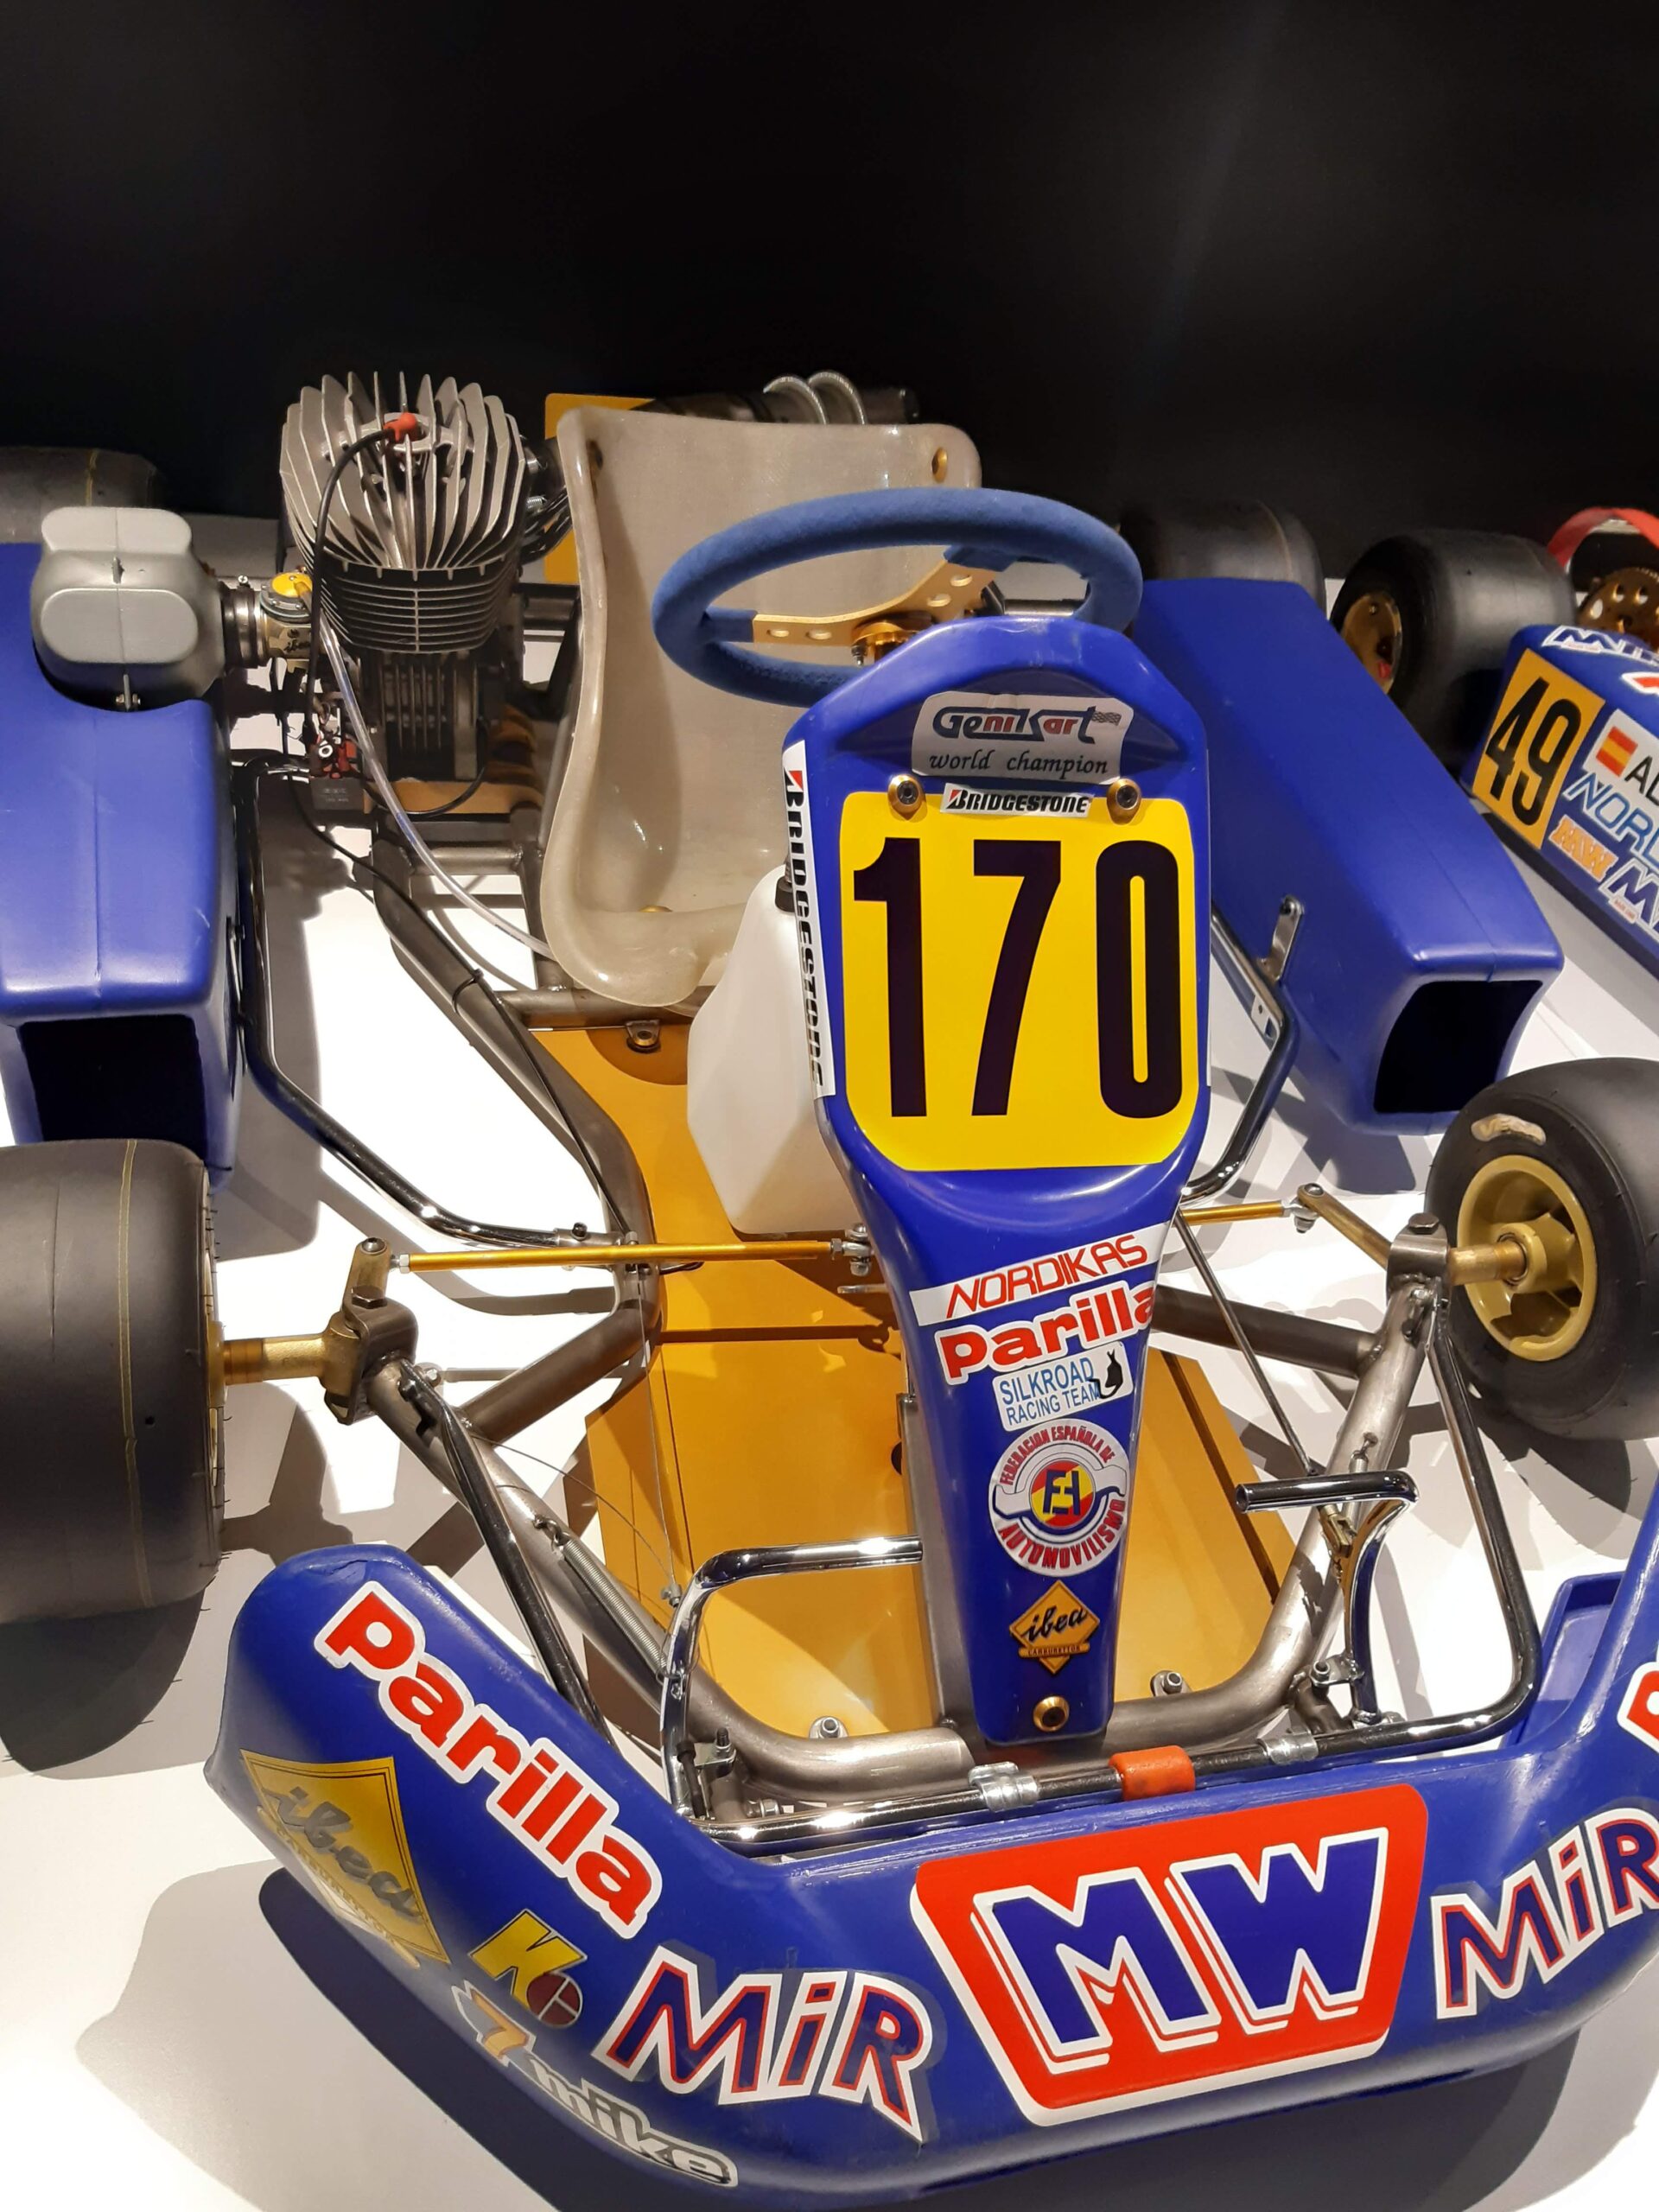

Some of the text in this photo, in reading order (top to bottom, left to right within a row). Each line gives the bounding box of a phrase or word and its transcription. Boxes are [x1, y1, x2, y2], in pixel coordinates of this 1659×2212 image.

[929, 748, 1109, 779] world champion
[1484, 677, 1582, 826] 49
[945, 789, 1090, 814] BRIDGESTONE
[853, 836, 1183, 1119] 170
[946, 1235, 1148, 1319] NORDIKAS
[938, 1286, 1156, 1380] Parilla
[999, 1357, 1095, 1406] SILKROAD
[1005, 1382, 1103, 1426] RACING TEAM
[1000, 1425, 1116, 1485] FEDERACION ESPAÑOLA DE
[997, 1498, 1127, 1570] AUTOMOVILISMO
[1020, 1605, 1089, 1642] ibea
[323, 1591, 653, 1927] Parilla
[973, 1829, 1389, 2074] MW
[1434, 1813, 1659, 2015] MiR
[594, 1948, 923, 2139] MiR
